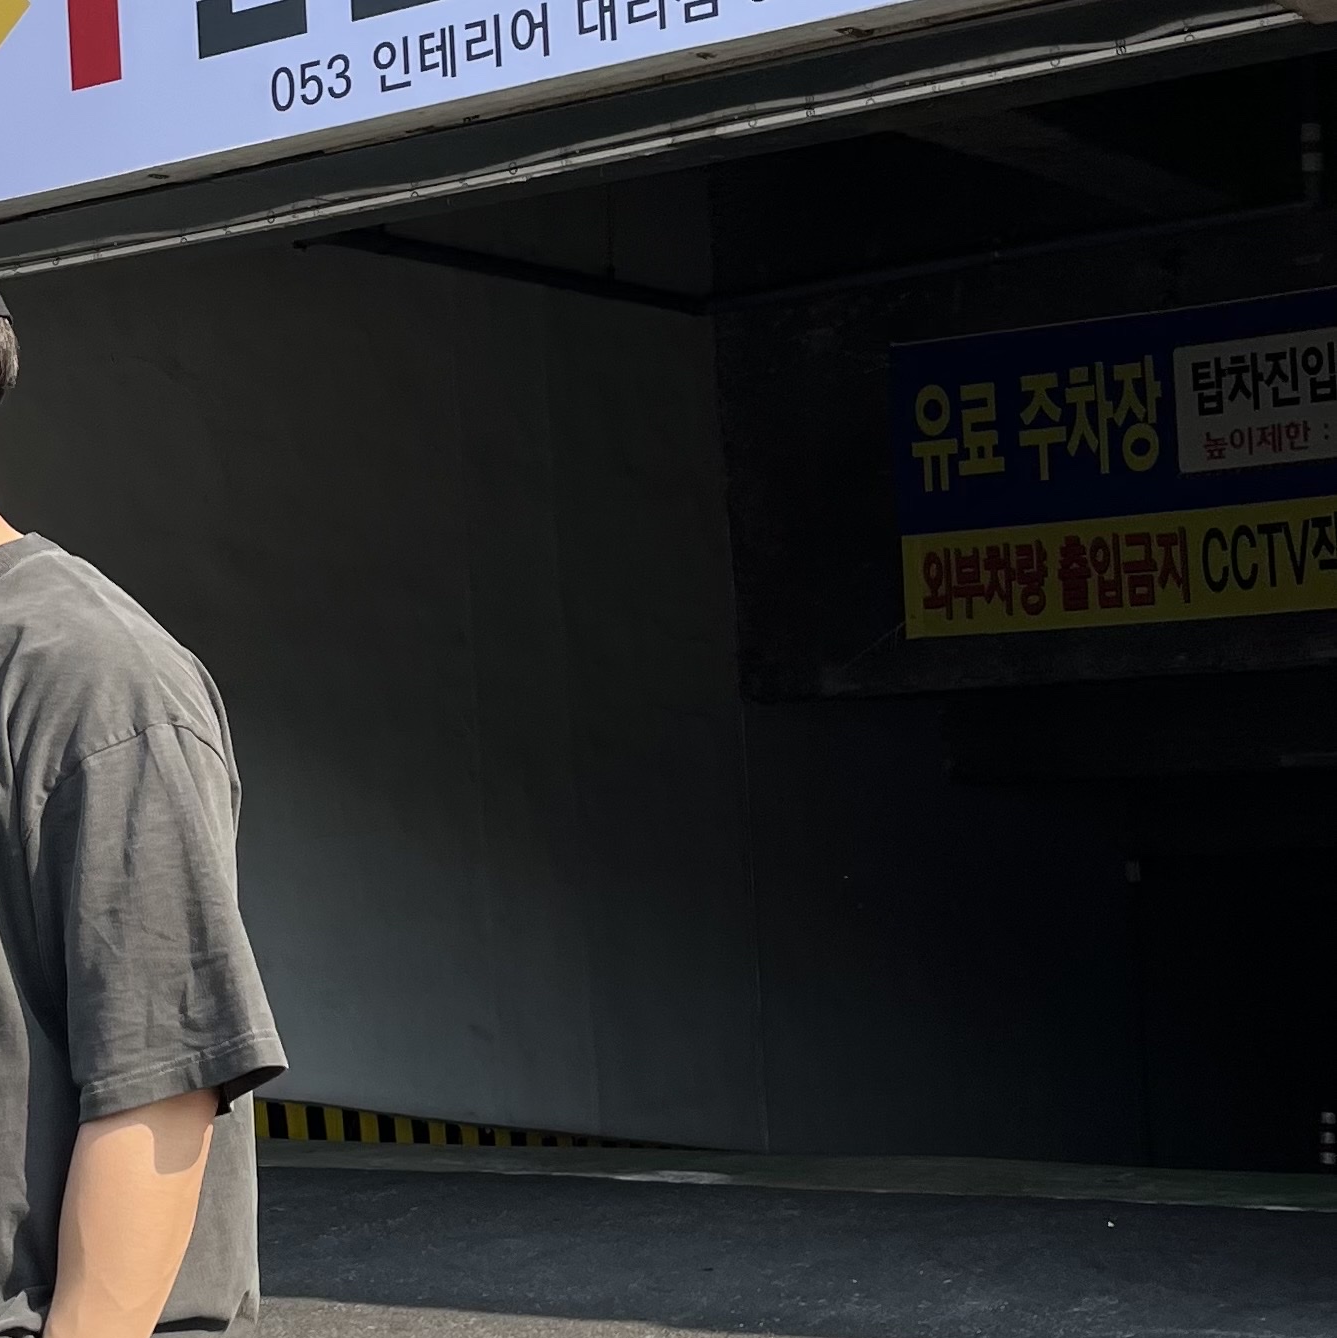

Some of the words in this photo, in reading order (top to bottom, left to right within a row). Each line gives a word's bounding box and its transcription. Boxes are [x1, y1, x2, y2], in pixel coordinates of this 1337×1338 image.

[271, 54, 352, 111] 053
[373, 2, 550, 92] 인테리어
[912, 381, 1006, 492] 유료
[1017, 354, 1162, 481] 주차장
[1191, 342, 1337, 417] 탑차진입
[1204, 420, 1311, 460] 높이제한
[922, 538, 1047, 620] 외부차량
[1058, 526, 1191, 611] 출입금지
